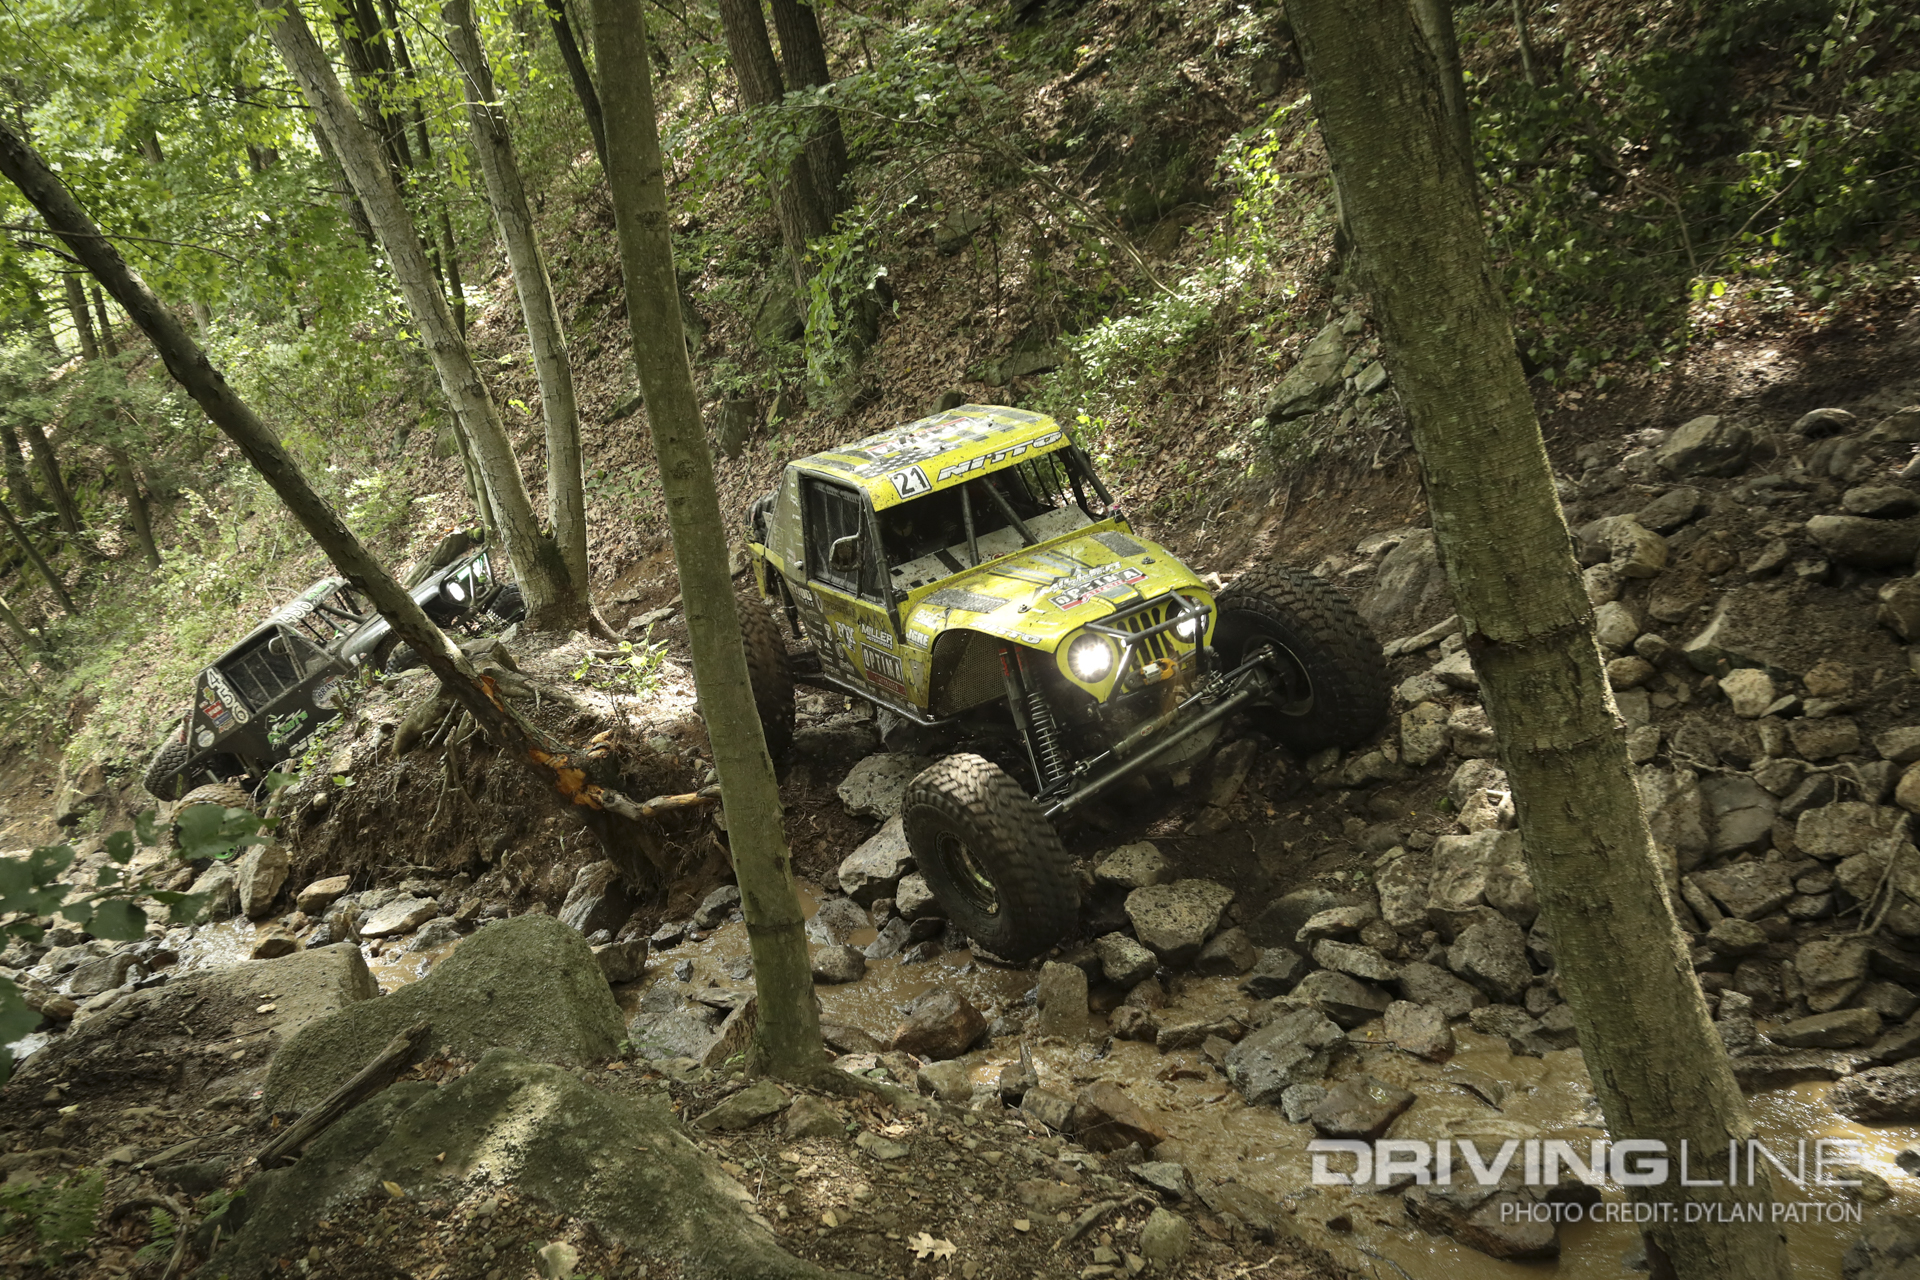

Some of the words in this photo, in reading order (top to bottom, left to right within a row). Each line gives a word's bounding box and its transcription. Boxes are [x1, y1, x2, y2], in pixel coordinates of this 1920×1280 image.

[937, 431, 1063, 482] NITTO
[893, 467, 927, 495] 21
[861, 624, 893, 645] MILLER
[968, 621, 1043, 645] NITTO
[863, 648, 903, 682] OPTIMA
[206, 667, 249, 724] 456
